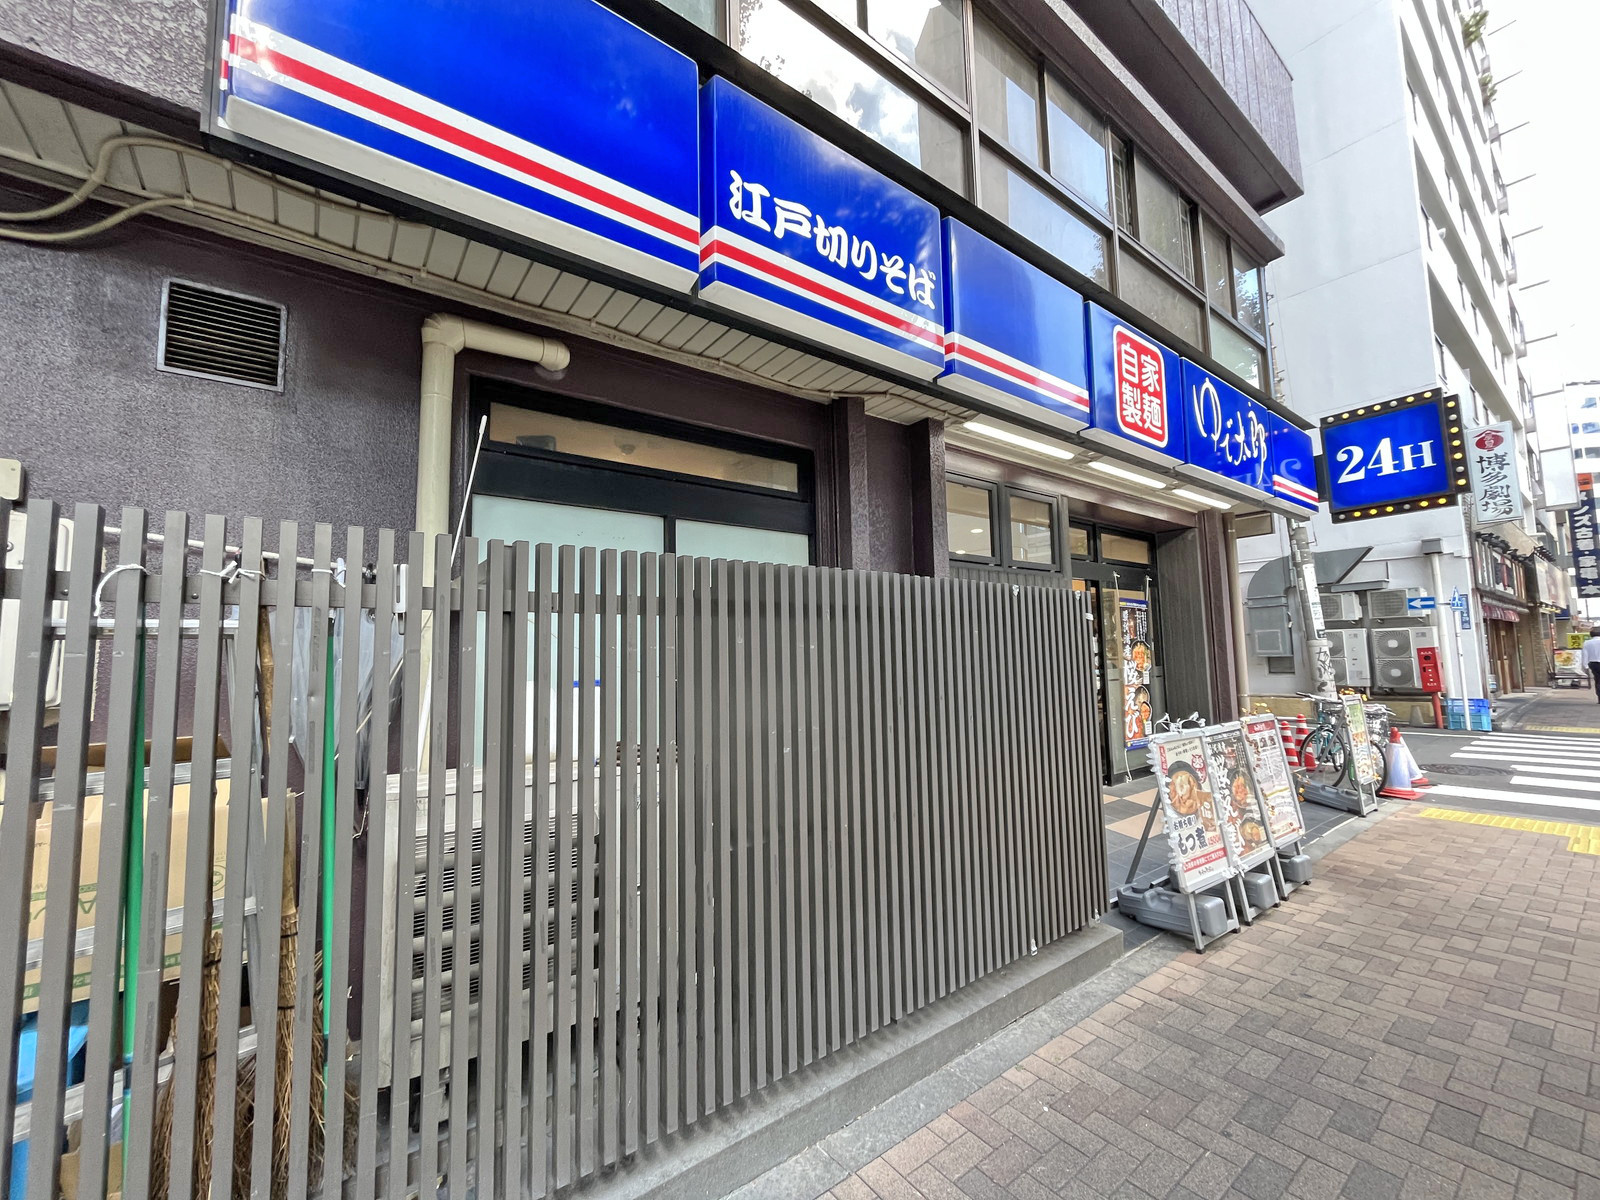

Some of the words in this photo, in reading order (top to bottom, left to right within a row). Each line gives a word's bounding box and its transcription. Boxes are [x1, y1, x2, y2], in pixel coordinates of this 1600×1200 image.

[729, 169, 936, 310] 江戸切りそば
[1121, 342, 1161, 392] 自家
[1121, 381, 1163, 435] 製麺
[1336, 437, 1437, 484] 24H
[1475, 452, 1514, 518] 博多劇場
[1123, 660, 1142, 739] 桜えび
[1178, 826, 1208, 855] もつ煮
